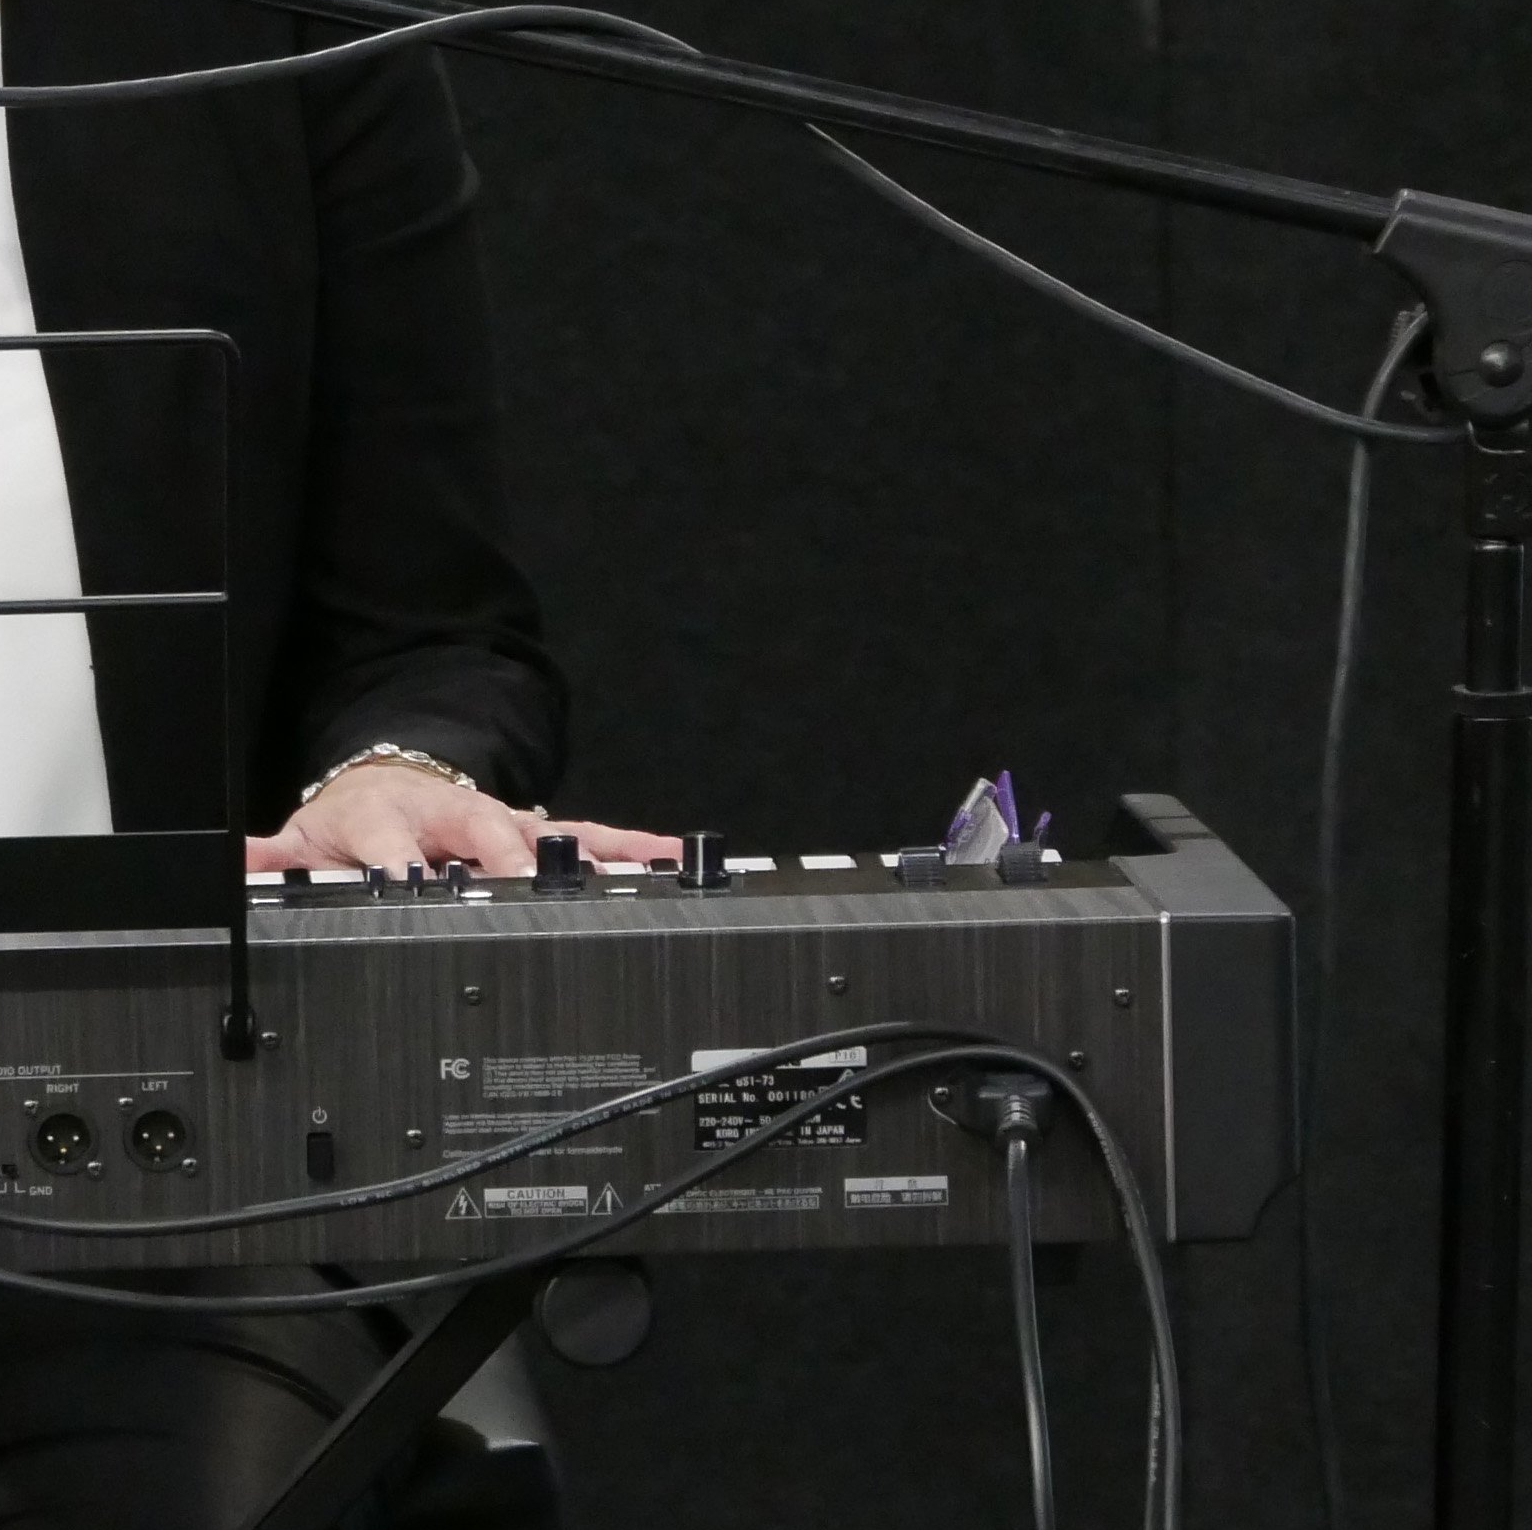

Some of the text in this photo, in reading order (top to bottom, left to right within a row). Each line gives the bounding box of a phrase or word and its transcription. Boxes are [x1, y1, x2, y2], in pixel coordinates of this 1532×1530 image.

[17, 1064, 63, 1077] OUTPUT
[46, 1082, 80, 1094] RIGHT
[141, 1080, 169, 1093] LEFT
[698, 1092, 737, 1105] SERIAL
[816, 1124, 845, 1136] JAPAN
[29, 1185, 53, 1197] GND
[507, 1188, 566, 1200] CAUTION
